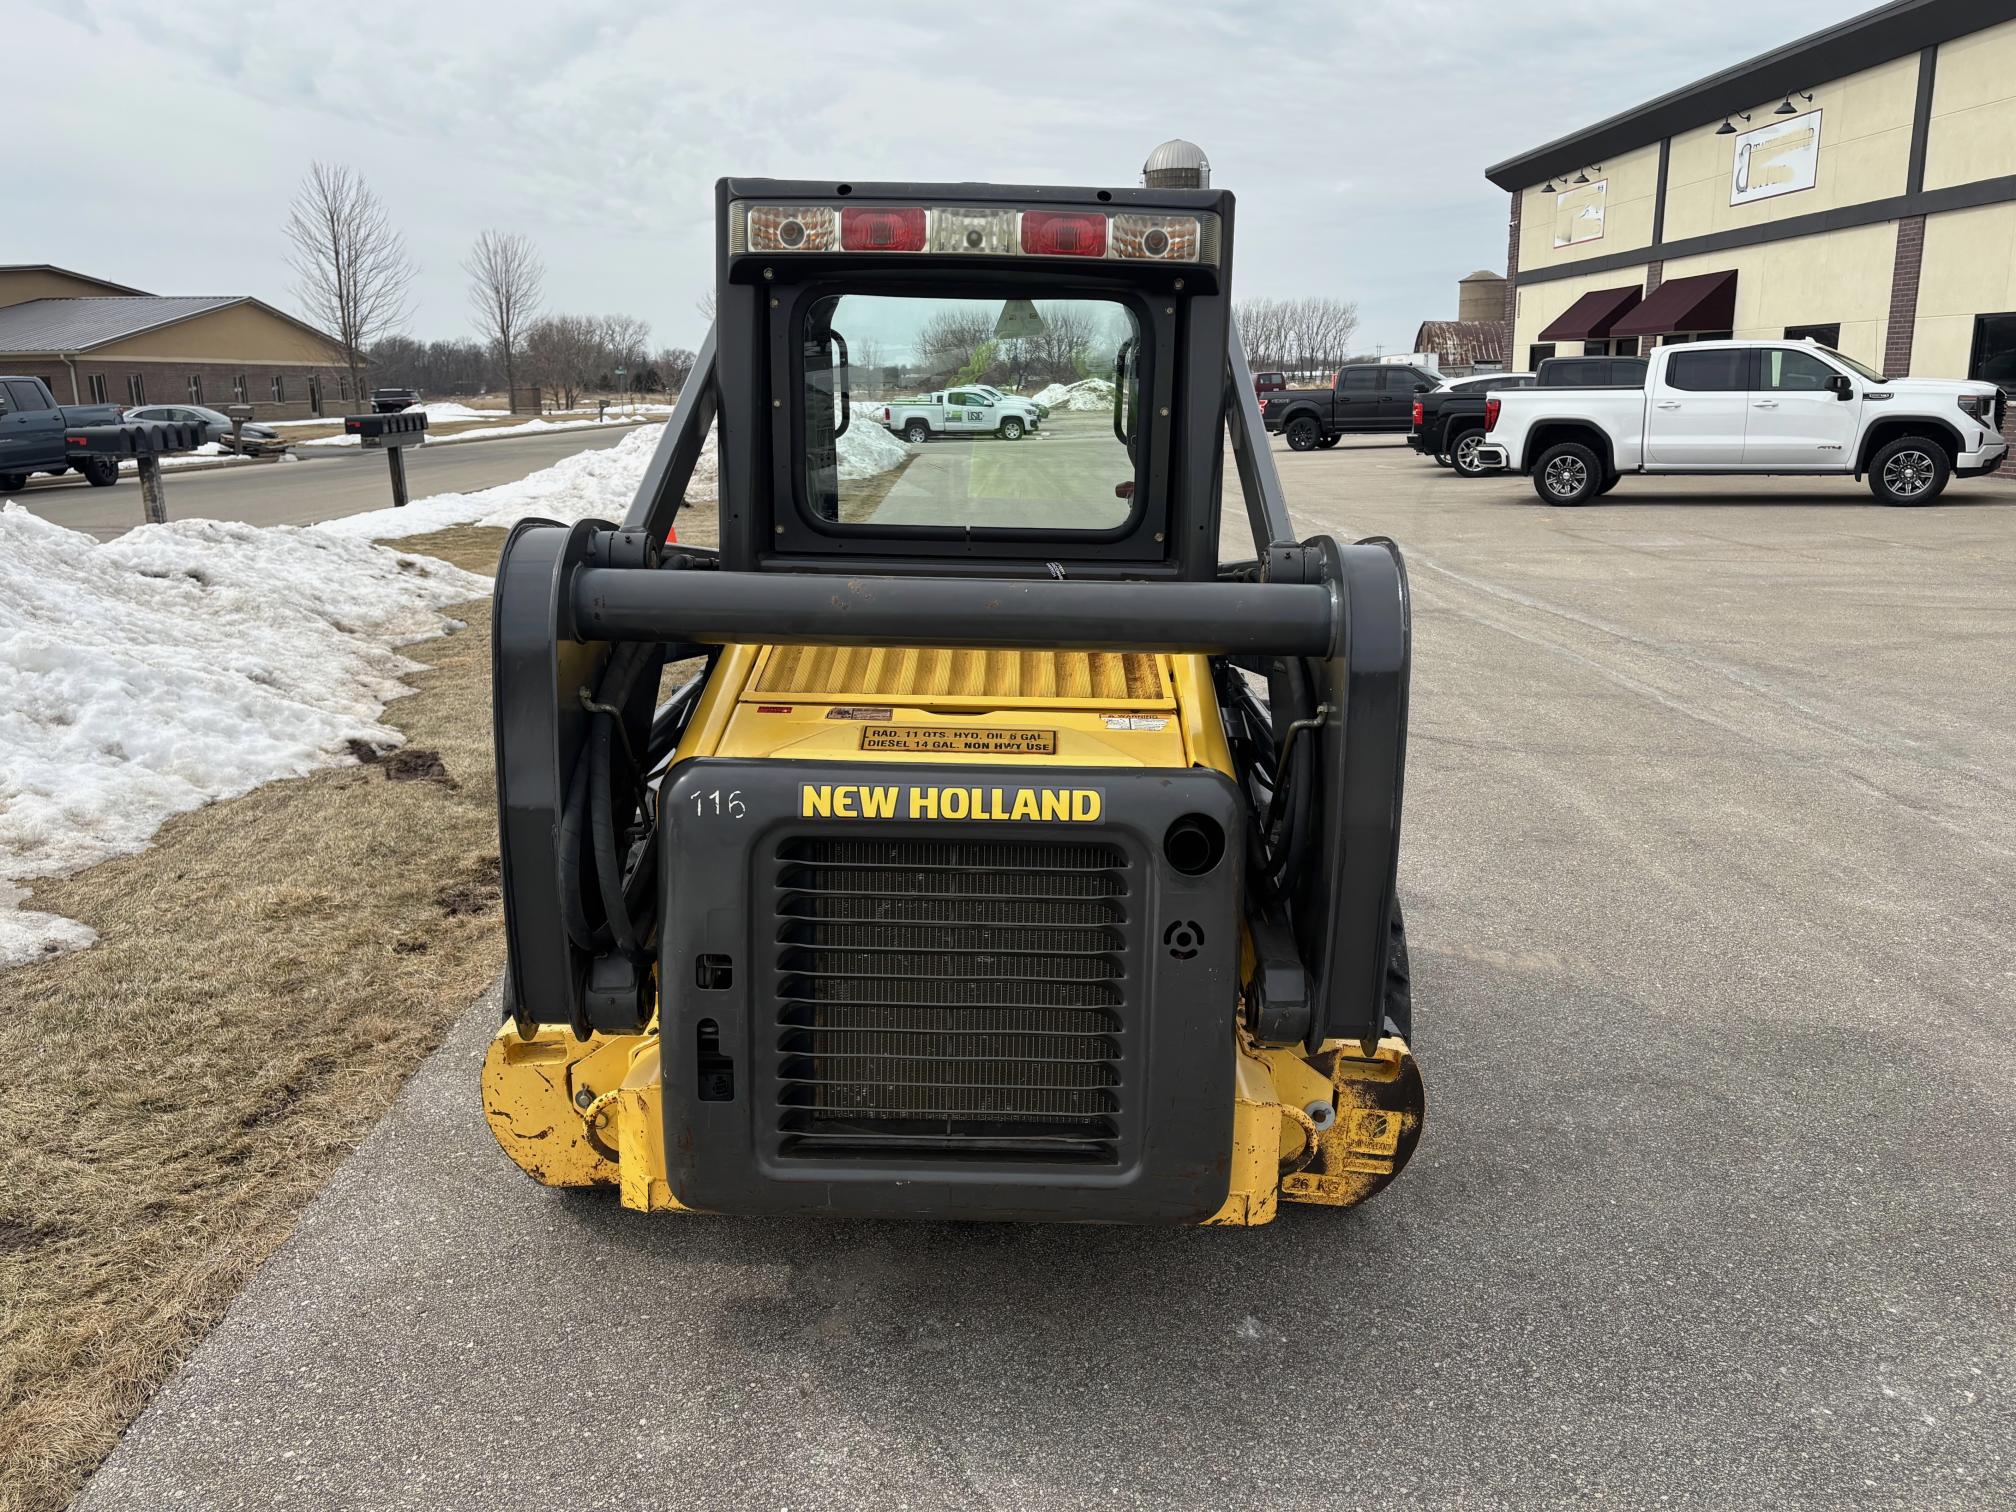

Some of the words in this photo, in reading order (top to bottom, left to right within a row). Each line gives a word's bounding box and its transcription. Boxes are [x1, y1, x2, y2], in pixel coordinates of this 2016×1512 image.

[872, 730, 900, 738] RAD.
[922, 731, 949, 739] QTS.
[954, 732, 982, 740] HYD.
[986, 732, 1005, 740] OIL
[867, 740, 910, 748] DIESEL
[932, 741, 960, 749] GAL.
[964, 742, 990, 750] NON
[1026, 743, 1050, 751] USE
[690, 790, 746, 819] 116
[802, 785, 899, 819] NEW
[908, 787, 1102, 822] HOLLAND
